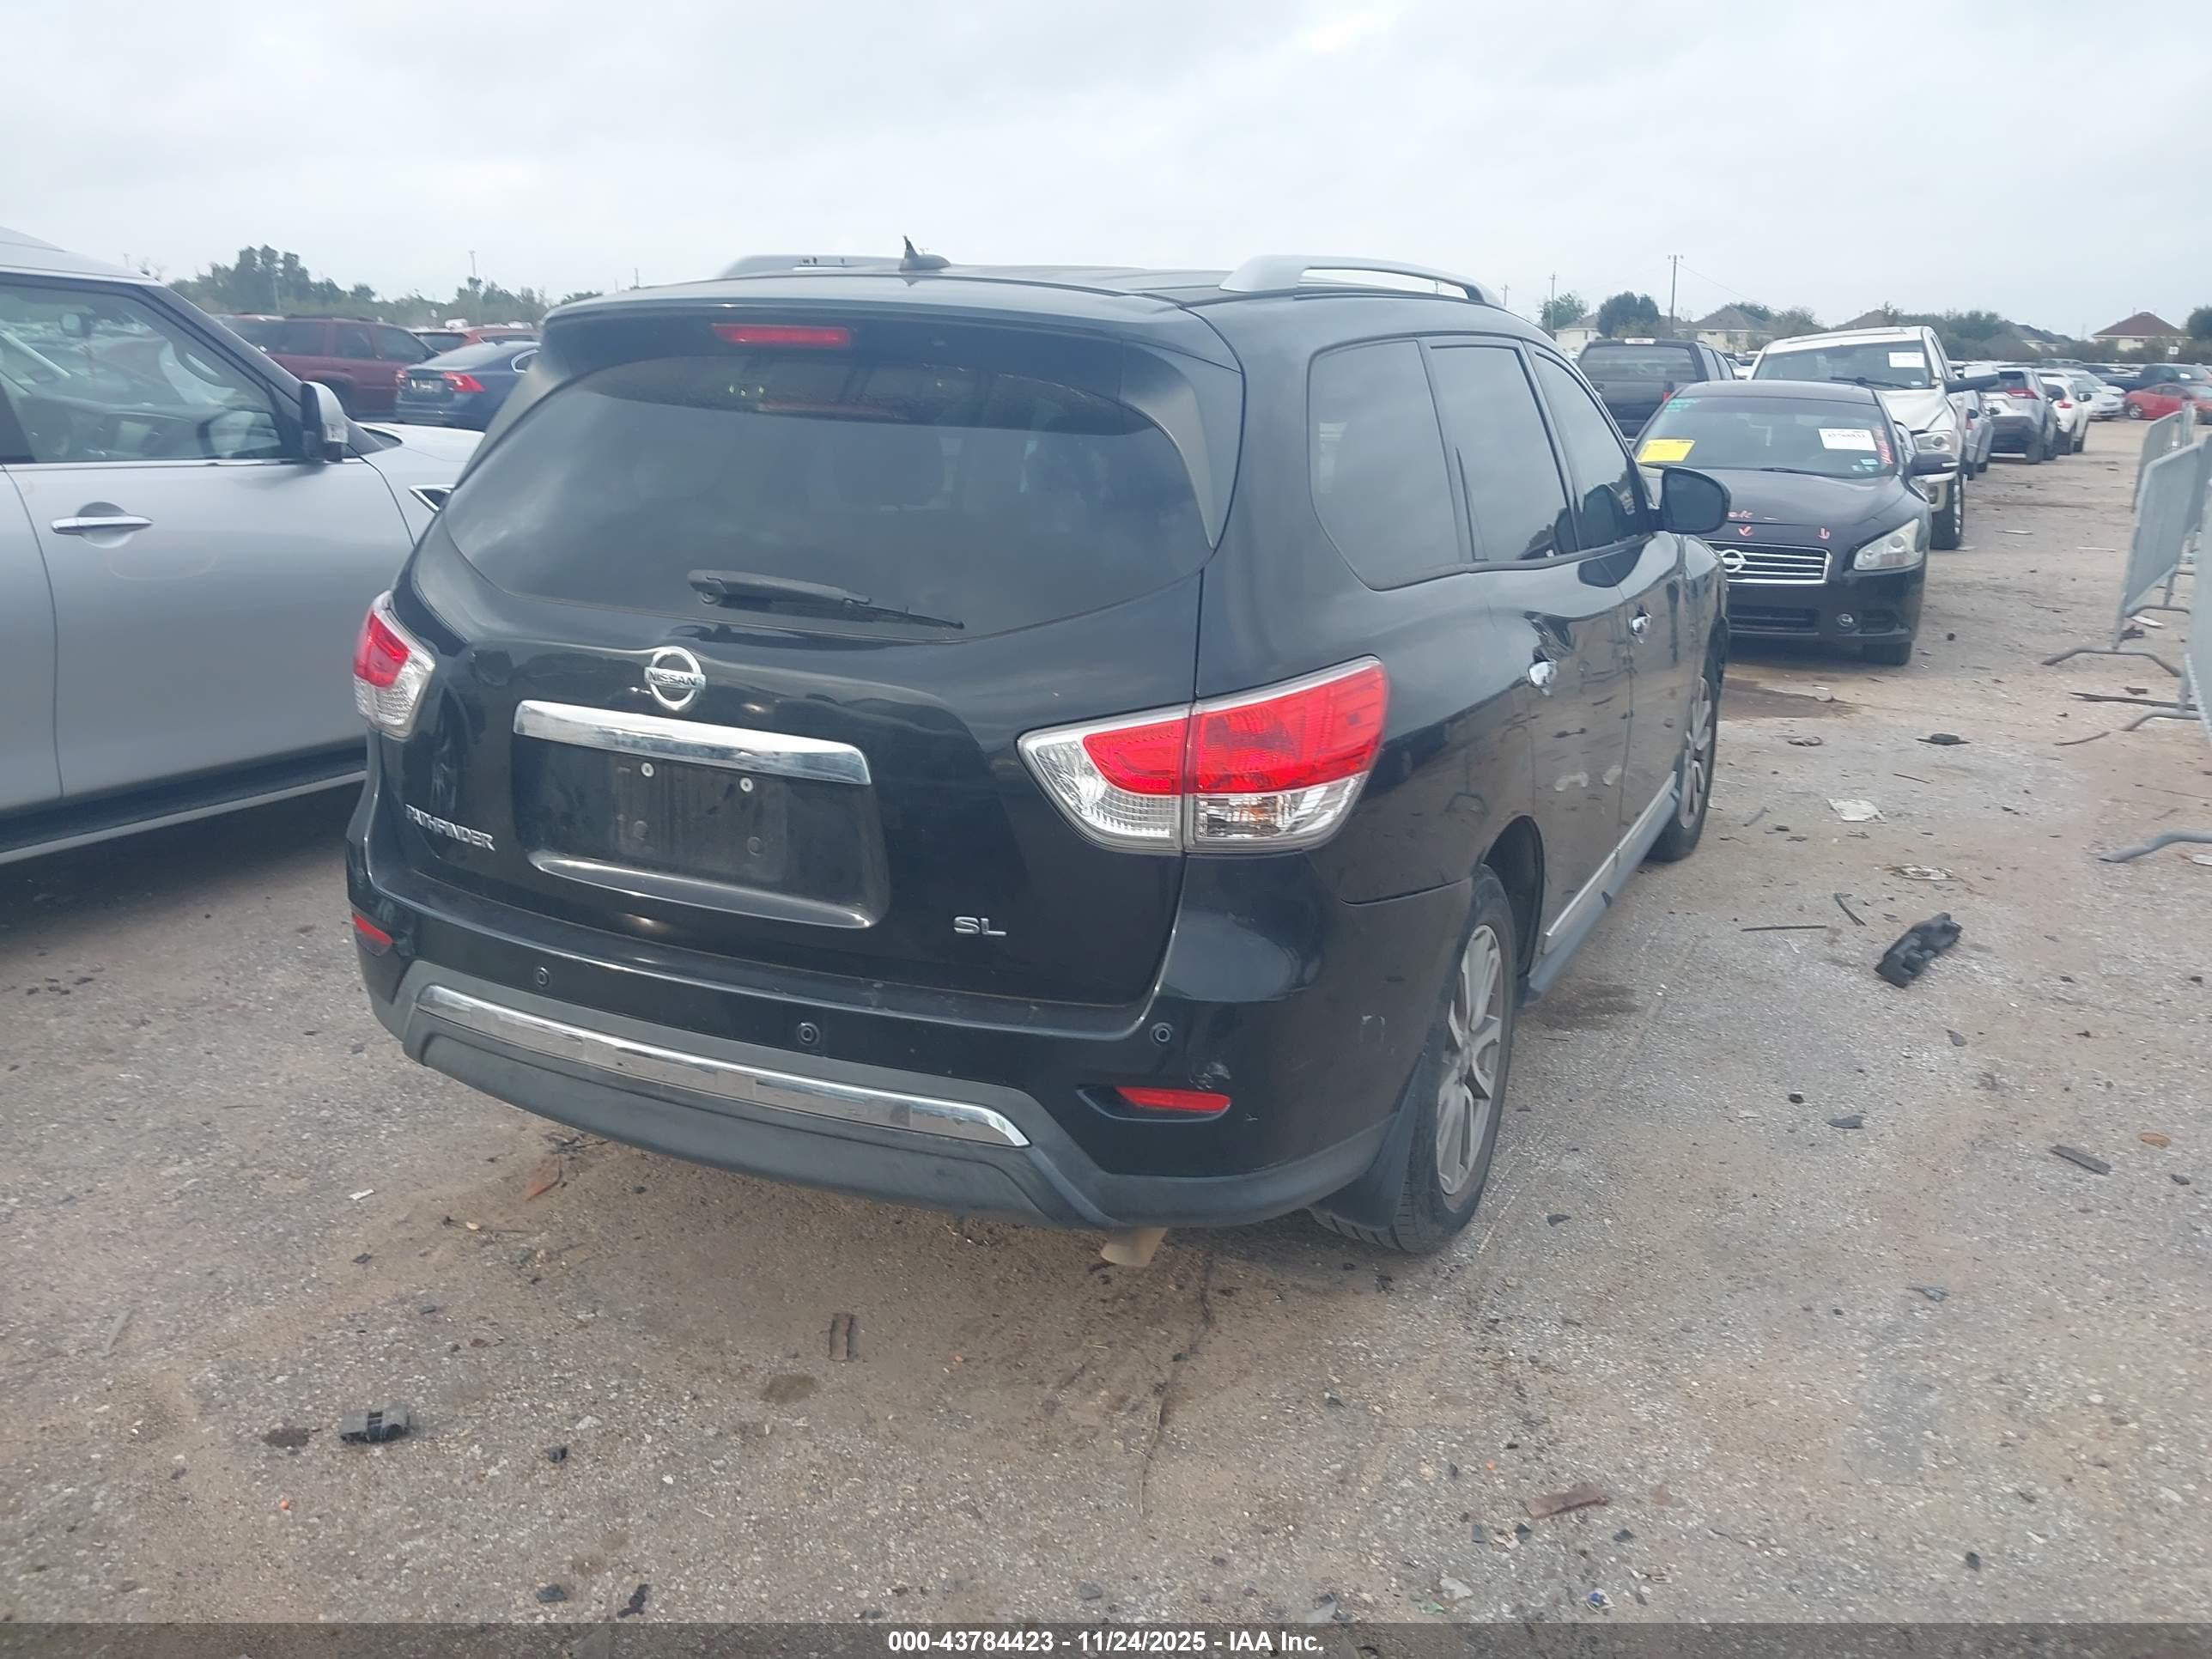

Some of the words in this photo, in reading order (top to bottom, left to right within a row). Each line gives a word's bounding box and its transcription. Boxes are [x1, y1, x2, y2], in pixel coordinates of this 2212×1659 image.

[648, 672, 696, 687] NISSAN
[405, 804, 495, 852] PATHFINDER
[953, 915, 1006, 936] SL
